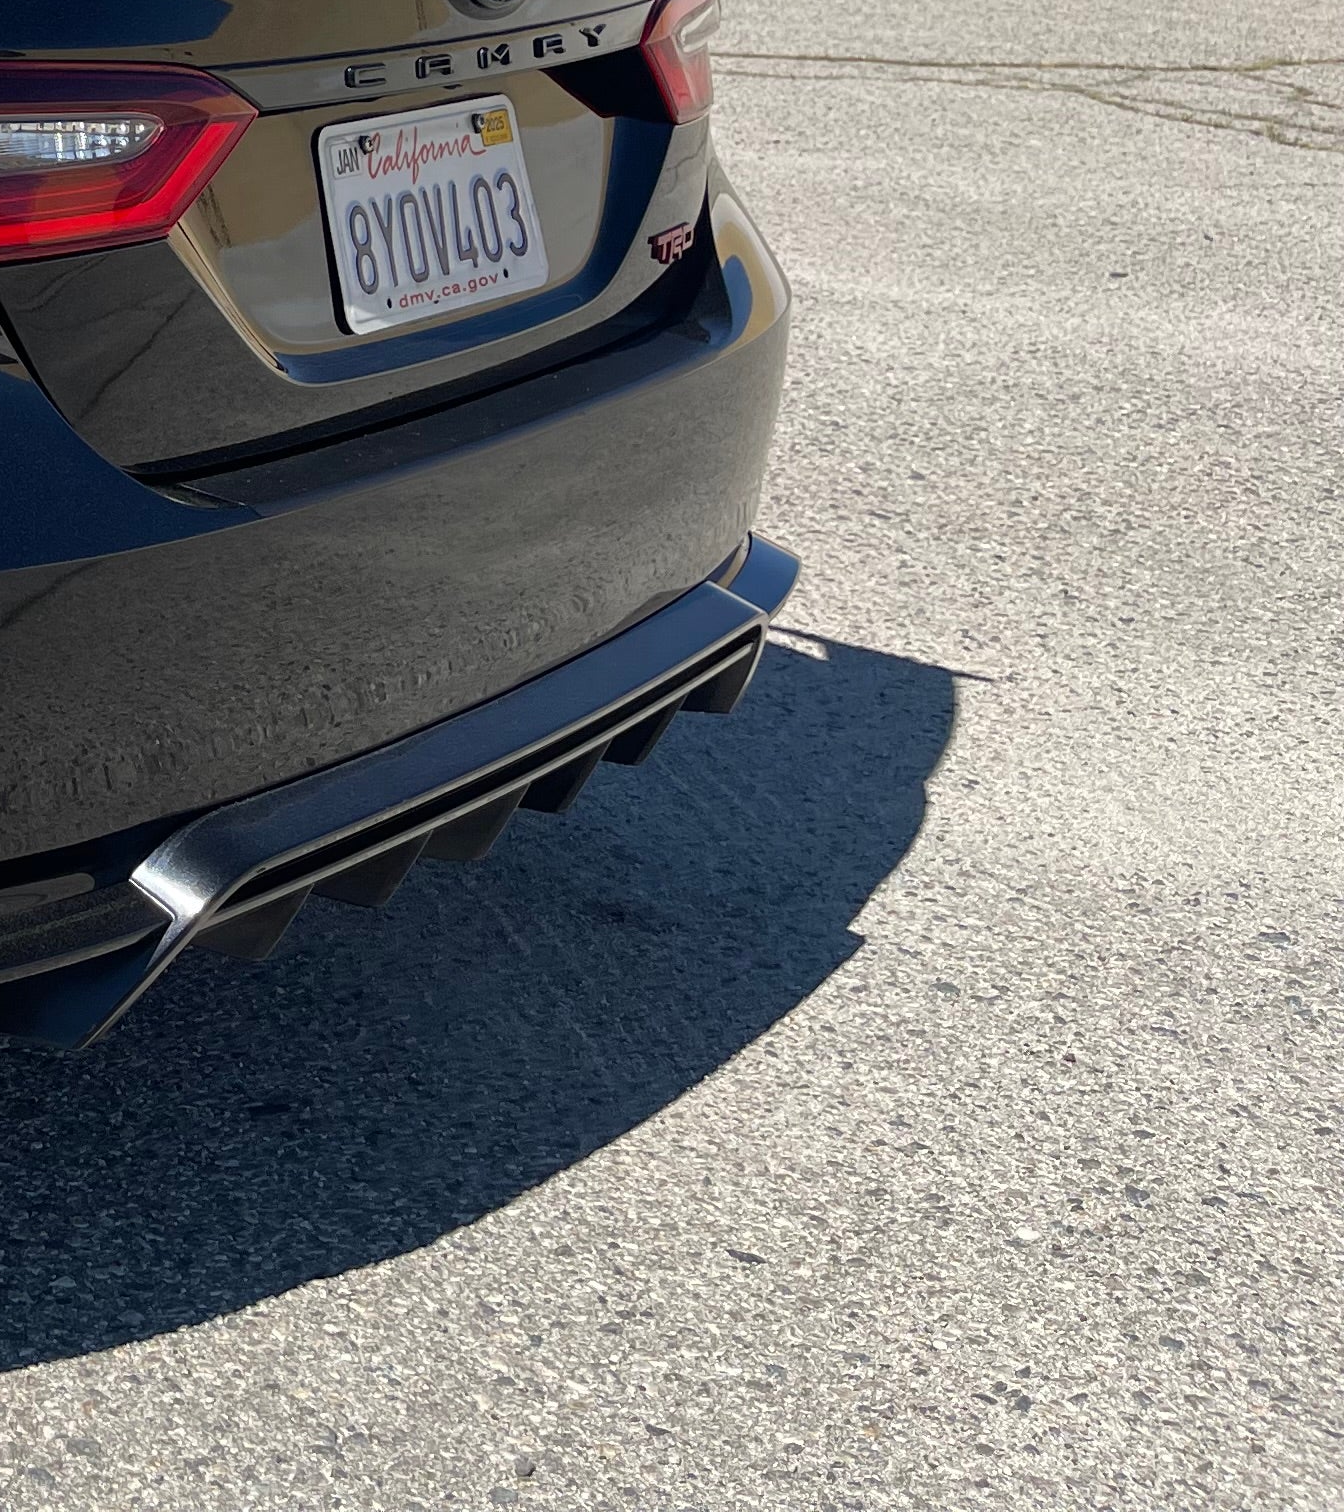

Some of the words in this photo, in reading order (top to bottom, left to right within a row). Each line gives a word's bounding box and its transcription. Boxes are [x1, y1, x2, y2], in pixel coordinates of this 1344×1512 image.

[344, 23, 607, 89] CAMRY
[336, 146, 361, 176] JAN
[366, 126, 487, 185] California
[647, 222, 695, 265] TRD
[398, 272, 500, 309] dmv.ca.gov
